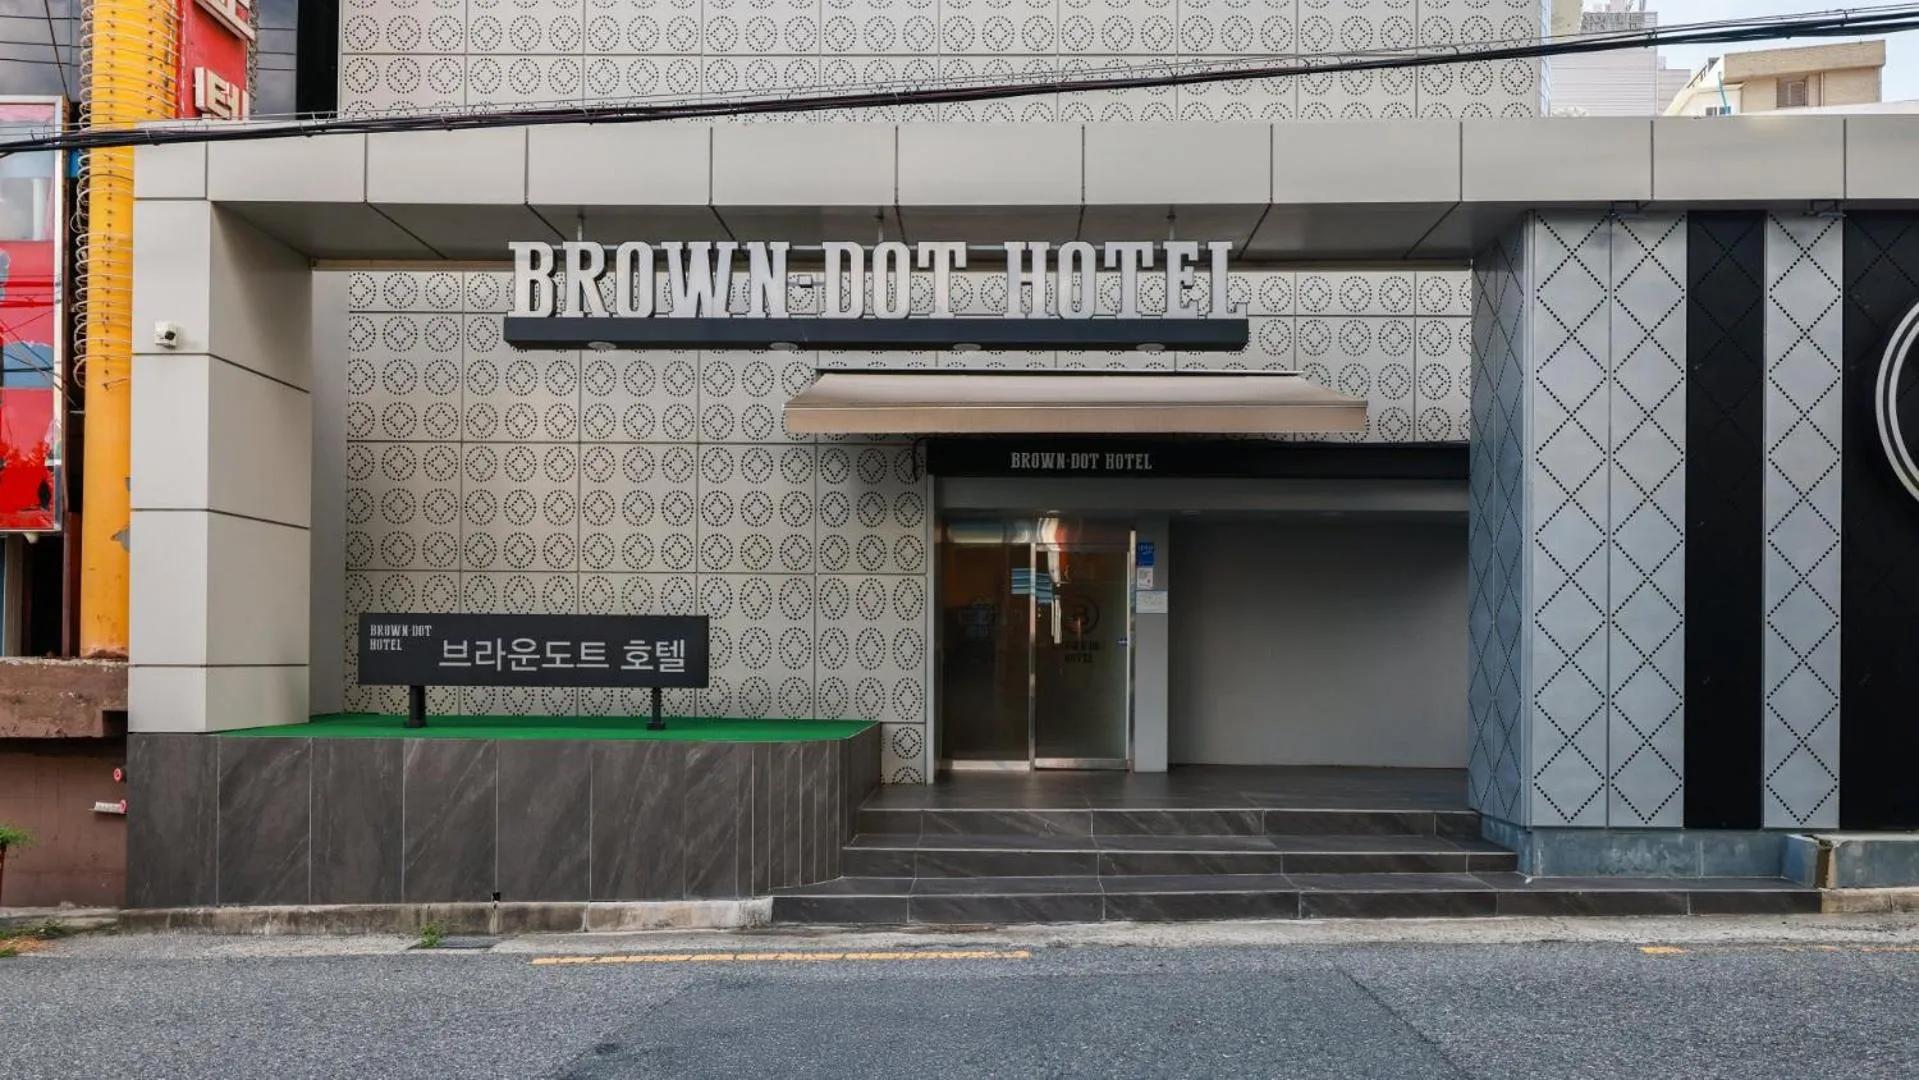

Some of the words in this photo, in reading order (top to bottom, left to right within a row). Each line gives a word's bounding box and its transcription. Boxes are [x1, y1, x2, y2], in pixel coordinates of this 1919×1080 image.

[1003, 241, 1248, 319] HOTEL
[1104, 453, 1153, 470] HOTEL
[369, 638, 403, 651] HOTEL
[439, 637, 610, 671] 브라운도트
[620, 639, 686, 673] 호텔
